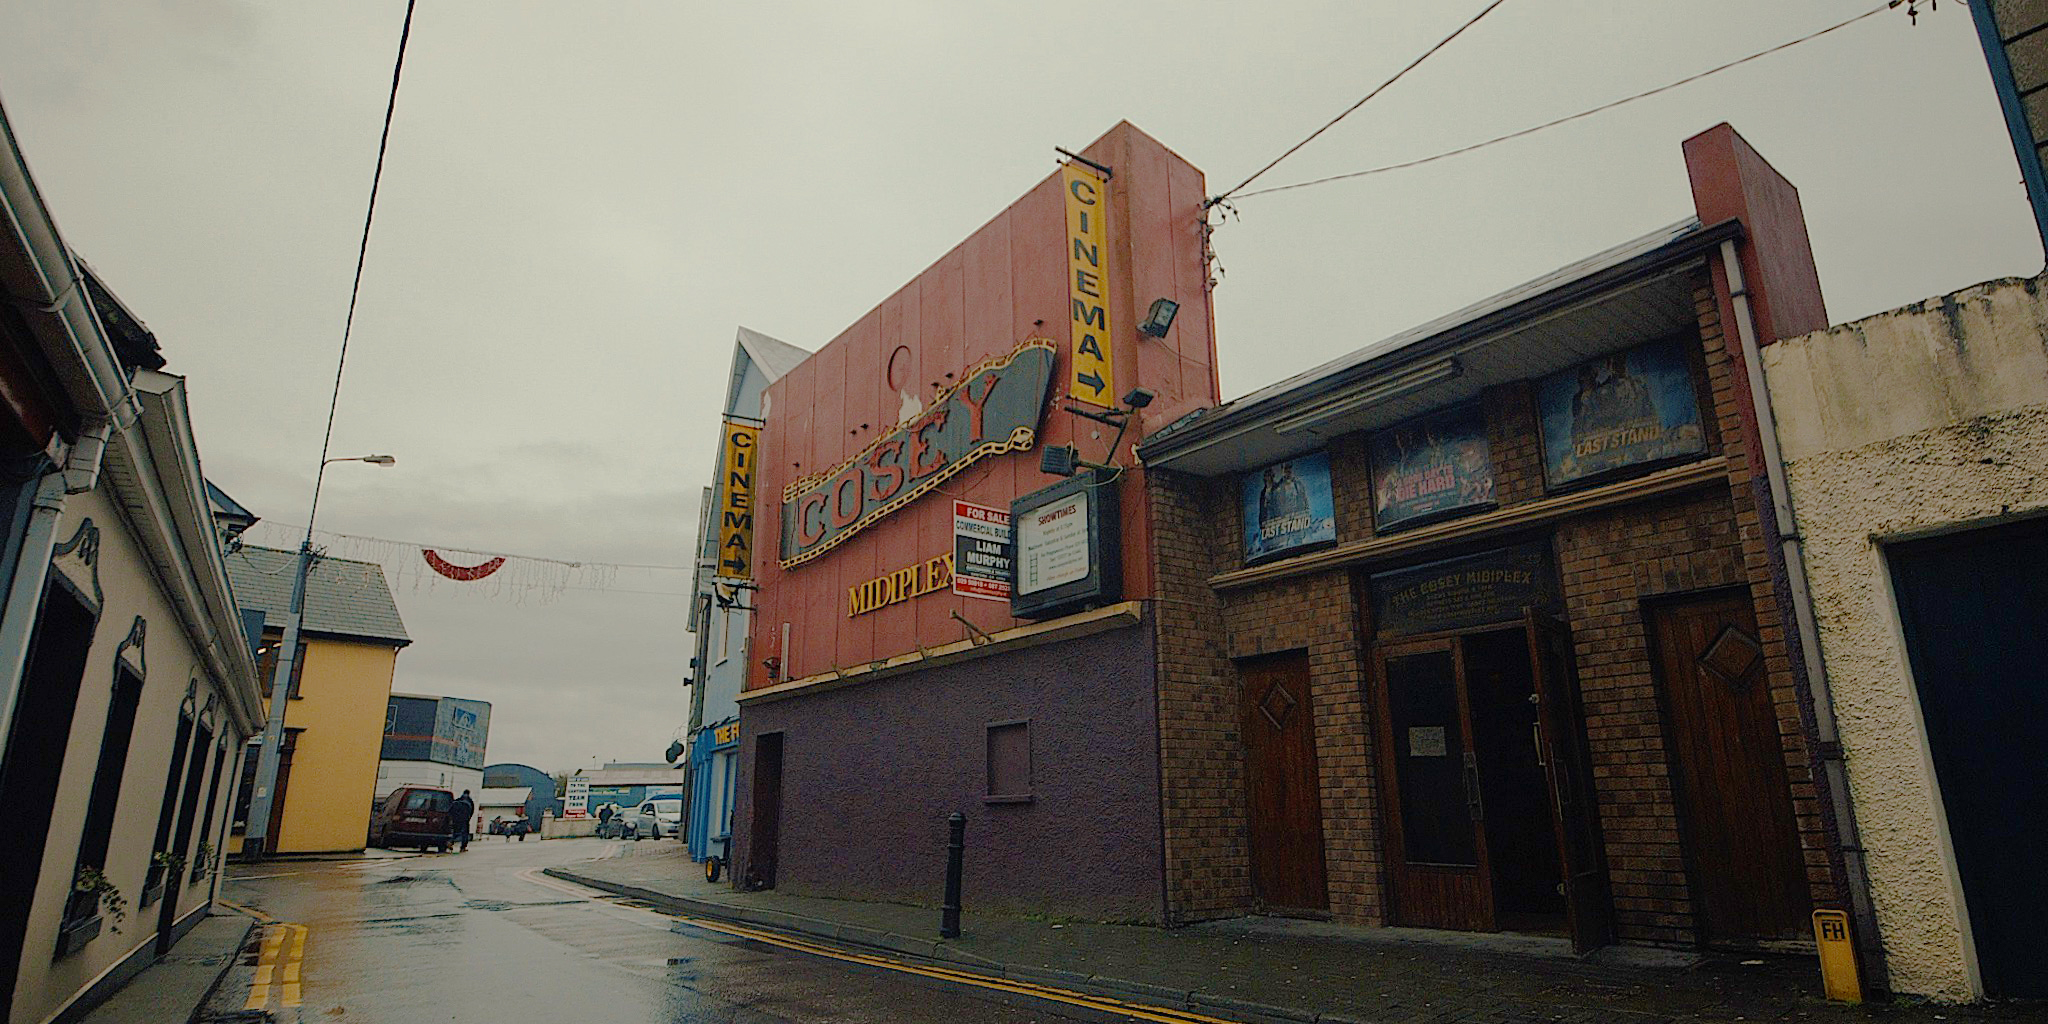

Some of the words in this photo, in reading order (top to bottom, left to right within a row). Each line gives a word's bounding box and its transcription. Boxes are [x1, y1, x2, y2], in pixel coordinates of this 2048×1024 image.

[1070, 179, 1105, 362] CINEMA
[1574, 432, 1608, 457] LAST
[1610, 425, 1660, 448] STAND
[798, 373, 1000, 549] COSEY
[723, 431, 752, 550] CINEMA
[1418, 476, 1456, 496] HARD
[966, 507, 986, 520] FOR
[986, 509, 1010, 525] SALE
[1038, 504, 1077, 527] SHOWTIMES
[956, 520, 994, 537] COMMERCIAL
[1261, 524, 1280, 541] LAST
[1281, 517, 1311, 535] STAND
[975, 540, 1001, 555] LIAM
[966, 552, 1011, 569] MURPHY
[847, 552, 954, 618] MIDIPLEX
[714, 726, 731, 745] THE
[1821, 922, 1845, 940] FH
